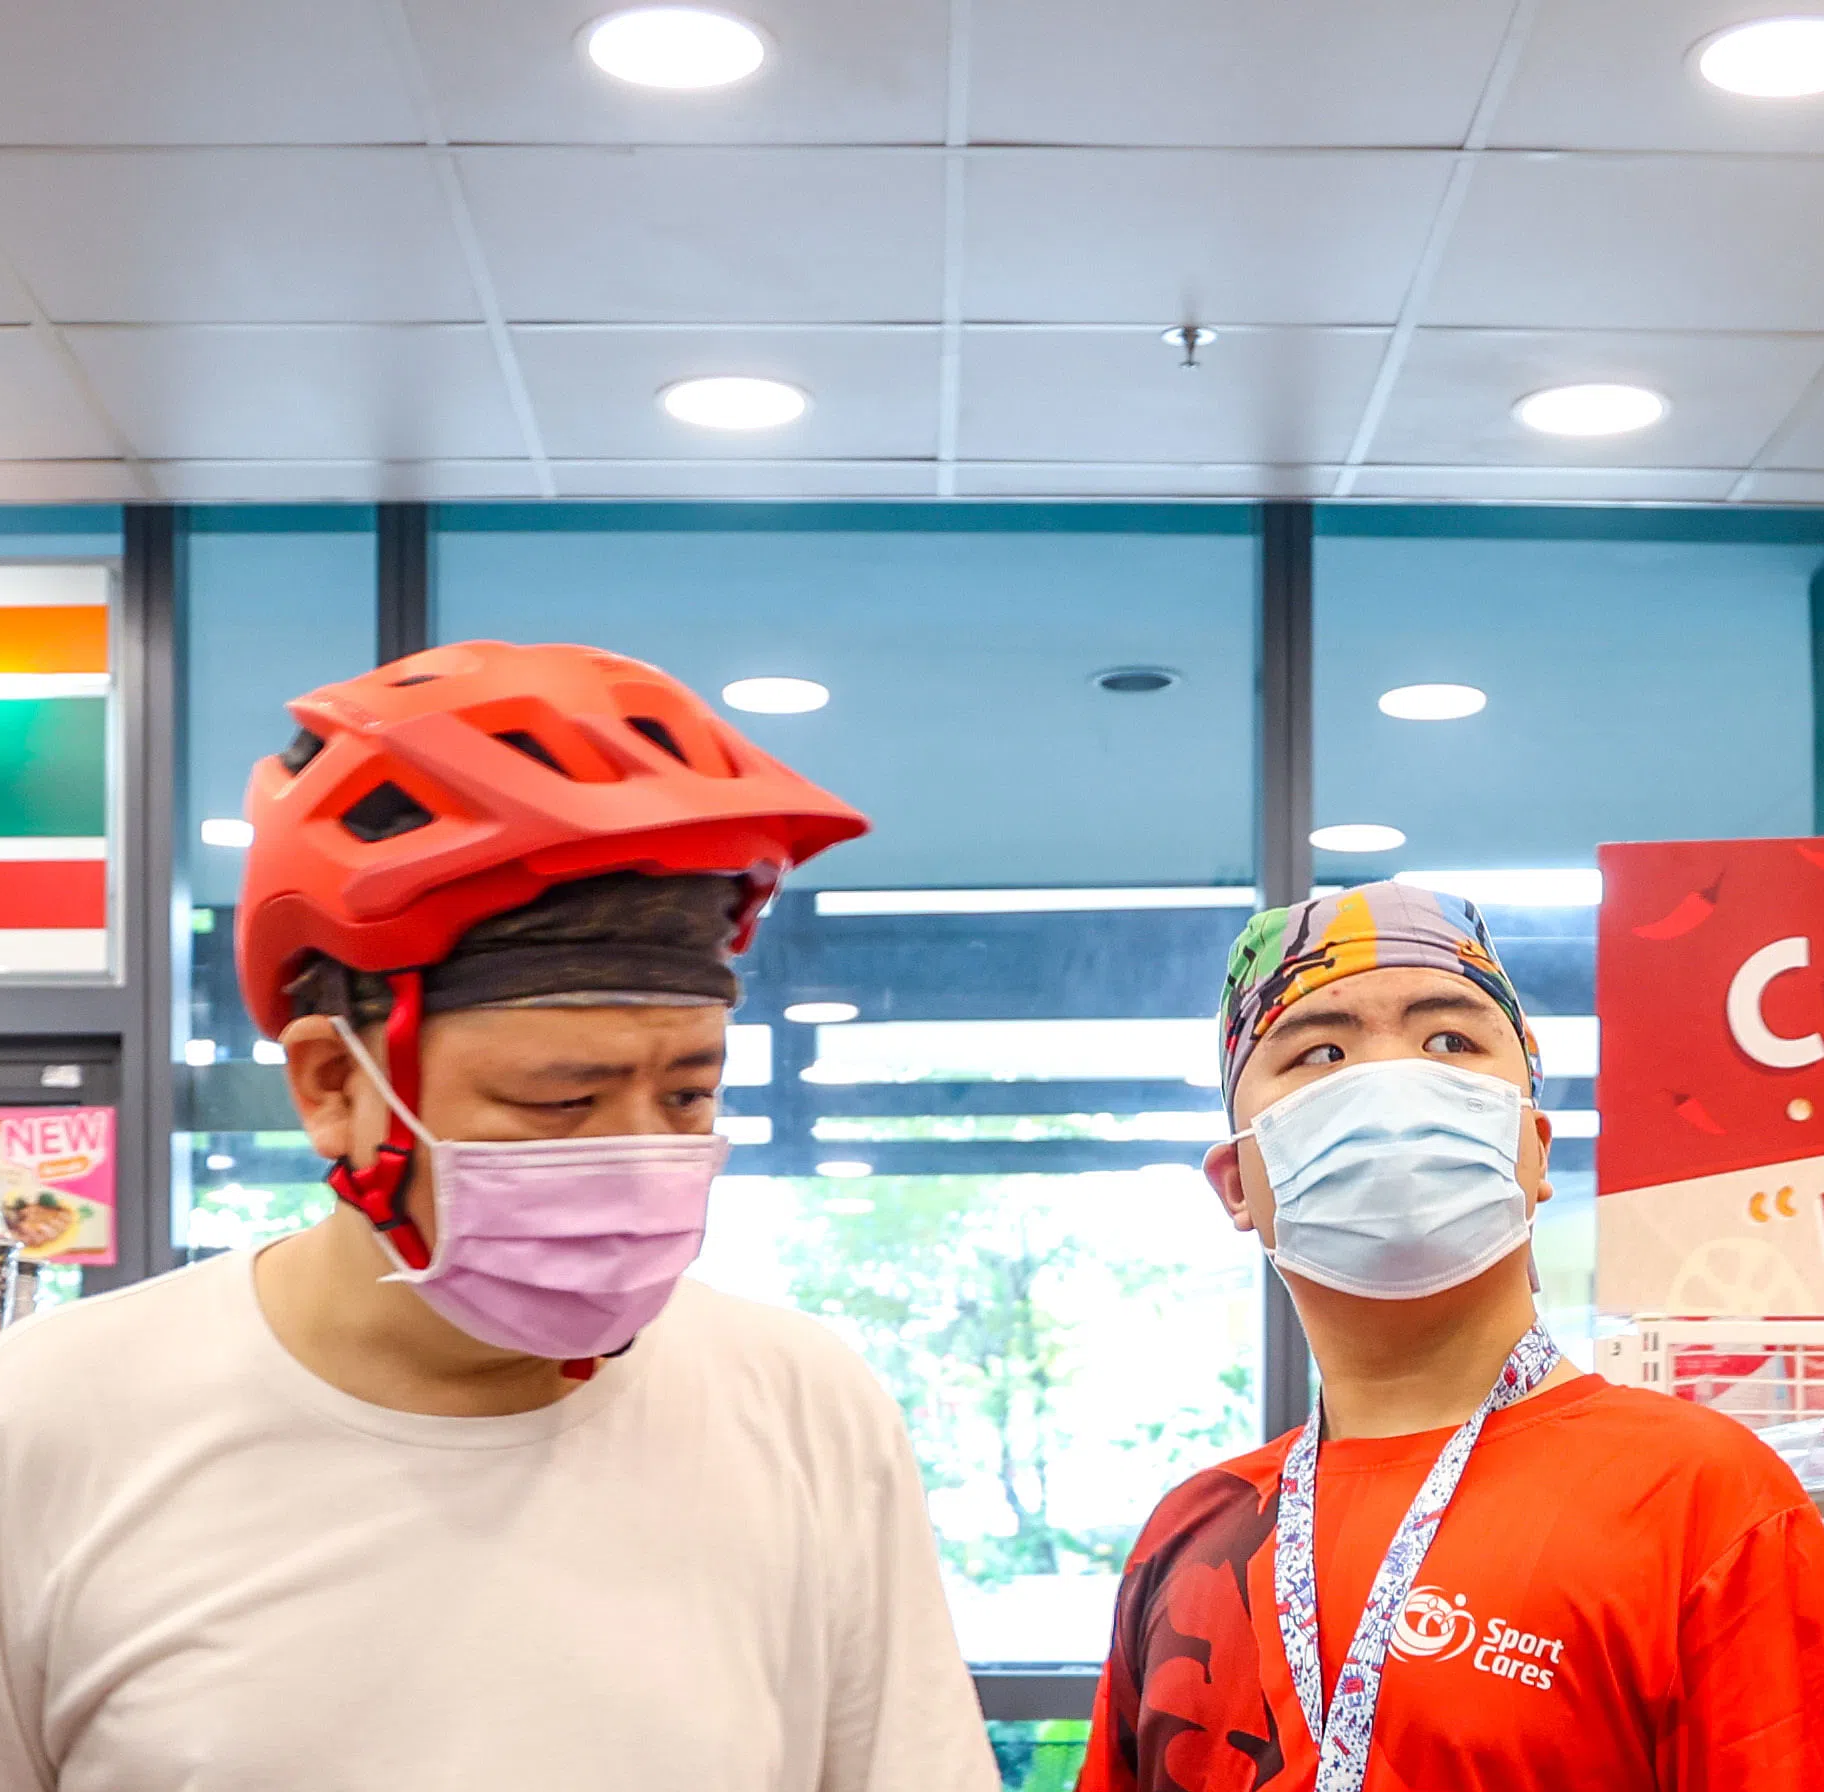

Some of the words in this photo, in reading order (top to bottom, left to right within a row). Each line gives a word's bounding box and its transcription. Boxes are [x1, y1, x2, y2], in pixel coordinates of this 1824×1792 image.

[2, 1112, 107, 1160] NEW
[1483, 1617, 1565, 1664] Sport
[1473, 1644, 1554, 1690] Cares
